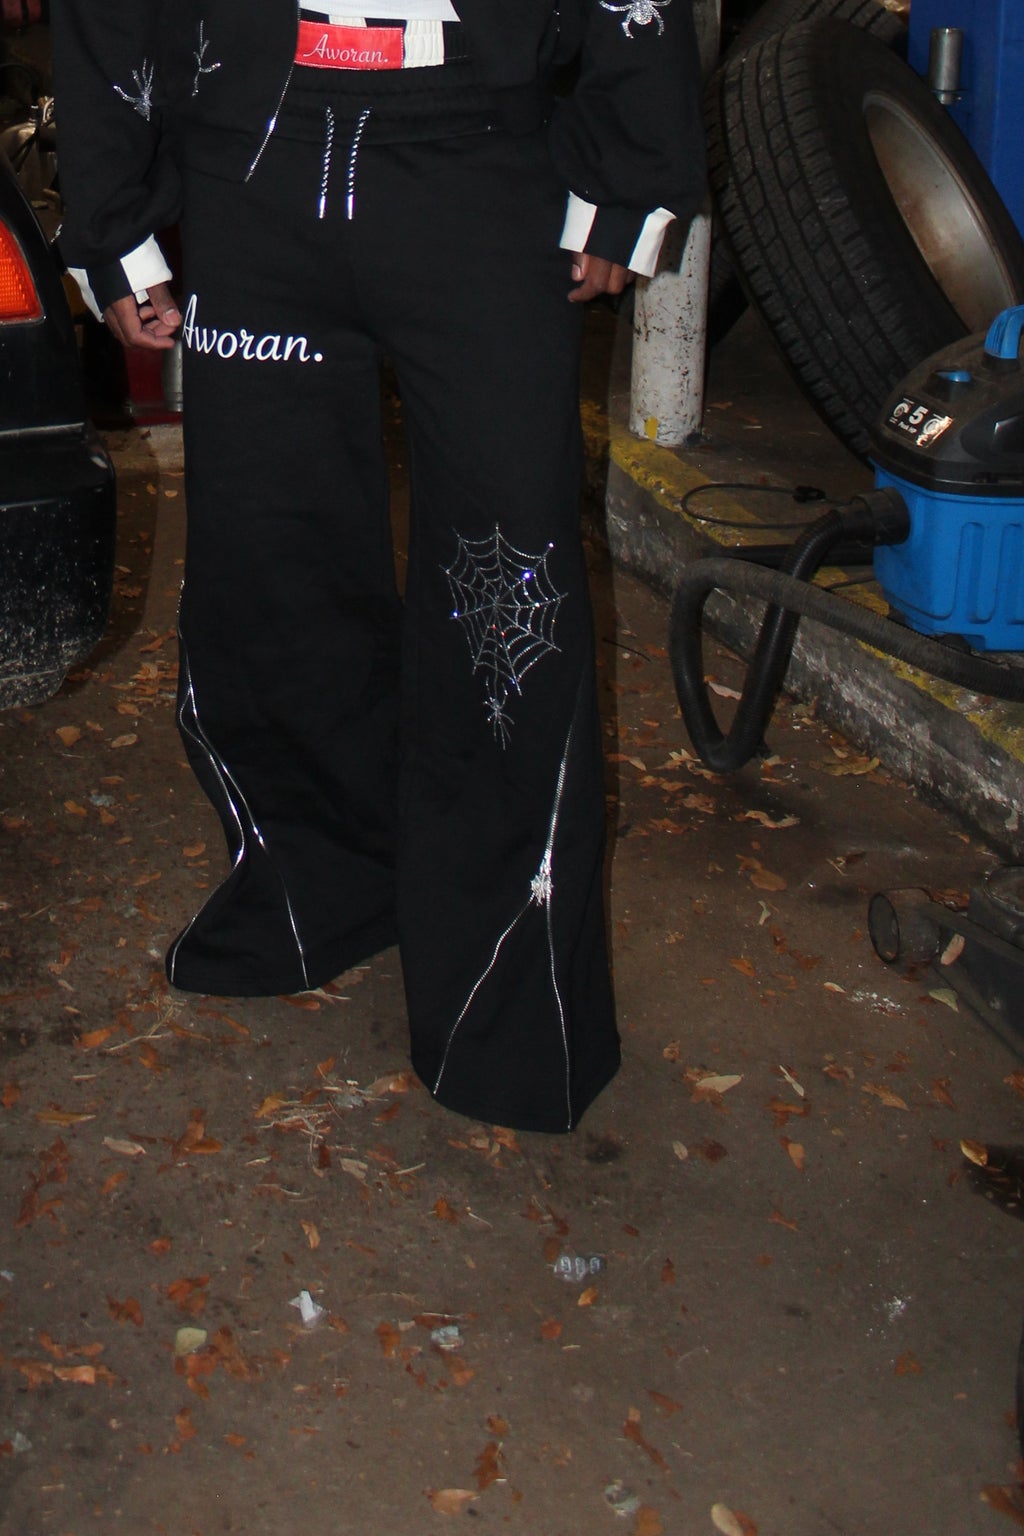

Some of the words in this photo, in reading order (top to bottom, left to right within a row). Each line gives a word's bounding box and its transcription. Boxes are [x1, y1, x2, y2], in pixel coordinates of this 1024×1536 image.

[302, 32, 389, 64] Aworan.
[181, 293, 324, 362] Aworan.
[908, 405, 929, 425] 5
